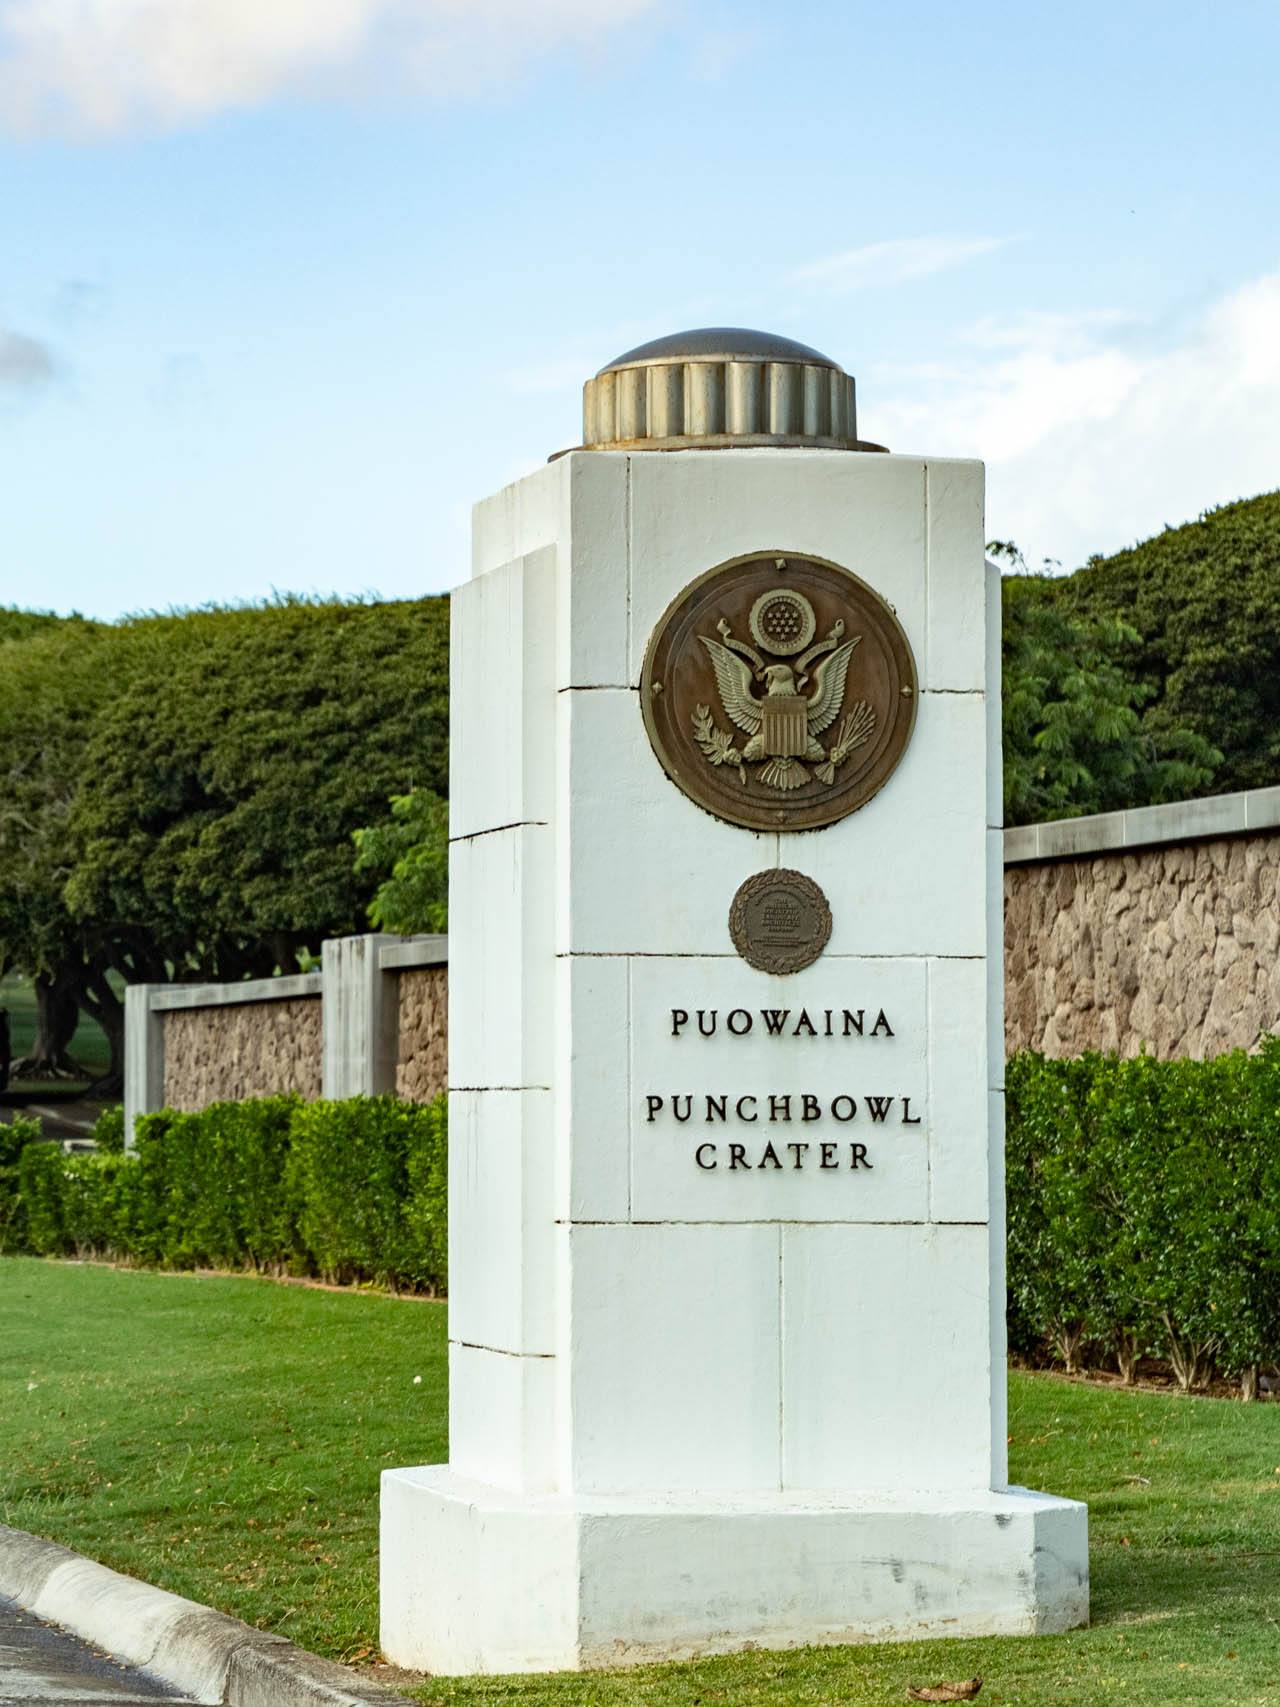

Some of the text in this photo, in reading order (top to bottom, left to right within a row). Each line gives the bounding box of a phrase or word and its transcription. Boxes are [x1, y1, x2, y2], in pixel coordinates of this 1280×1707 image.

[671, 1007, 895, 1037] PUOWAINA
[646, 1094, 921, 1124] PUNCHBOWL
[695, 1140, 874, 1170] CRATER
